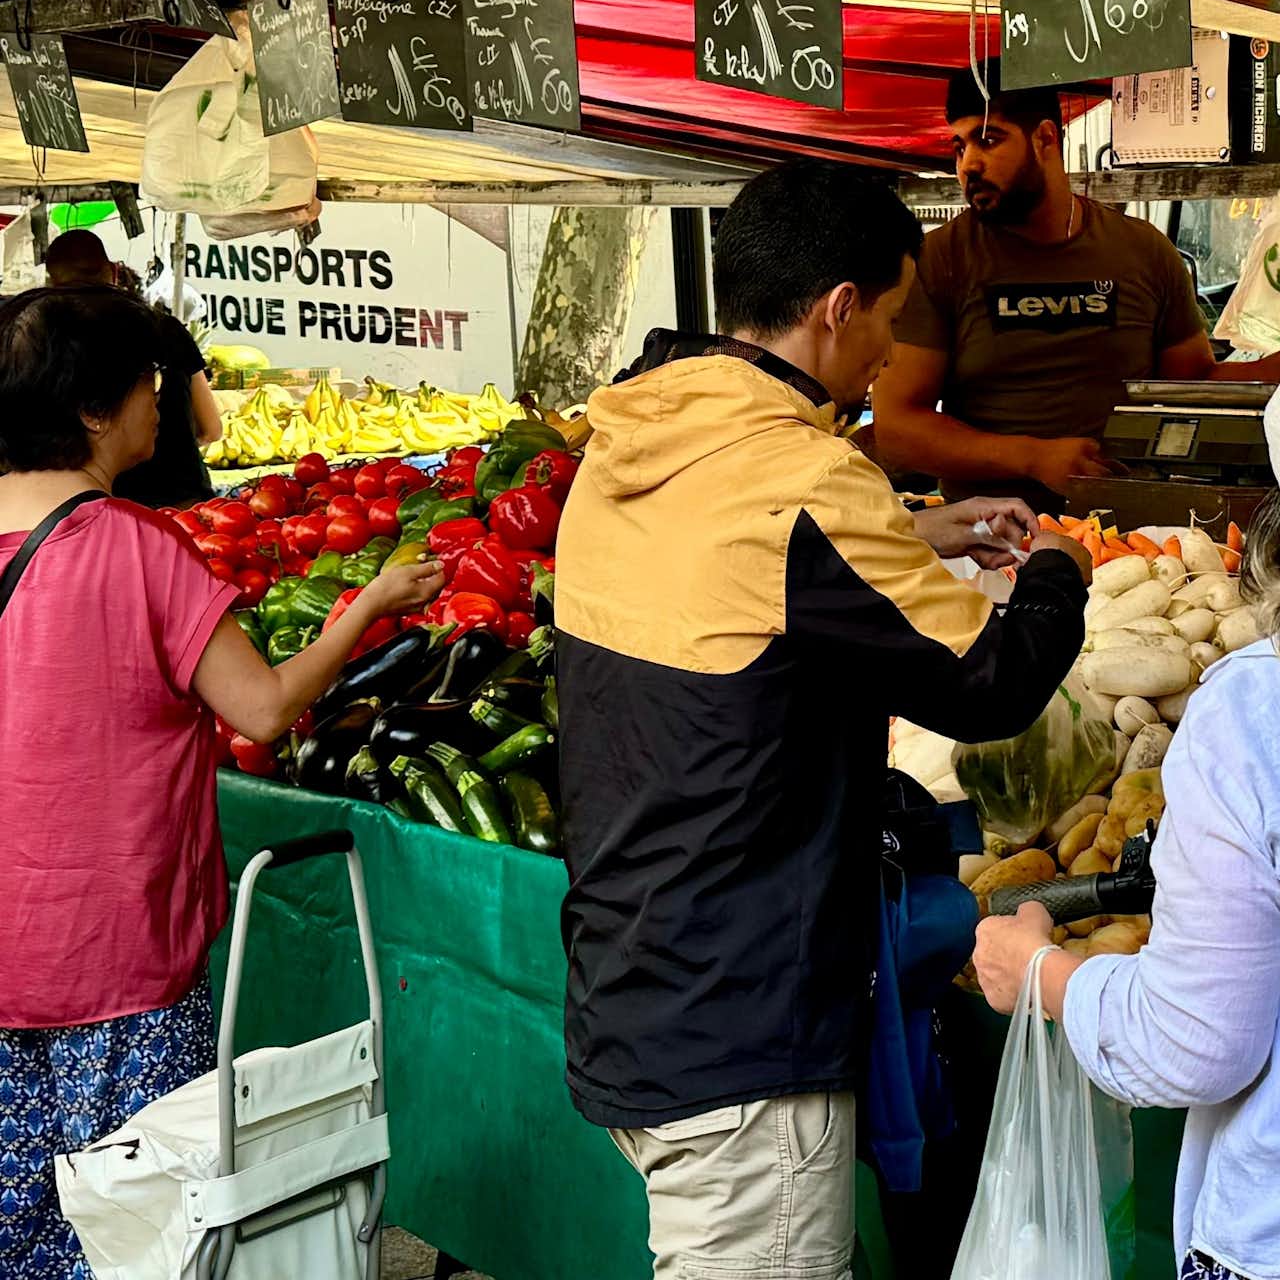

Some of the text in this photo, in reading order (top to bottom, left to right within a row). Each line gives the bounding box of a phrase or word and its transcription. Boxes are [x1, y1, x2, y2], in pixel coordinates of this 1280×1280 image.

[1254, 62, 1265, 152] DON RICARDO
[298, 301, 469, 351] PRUDENT
